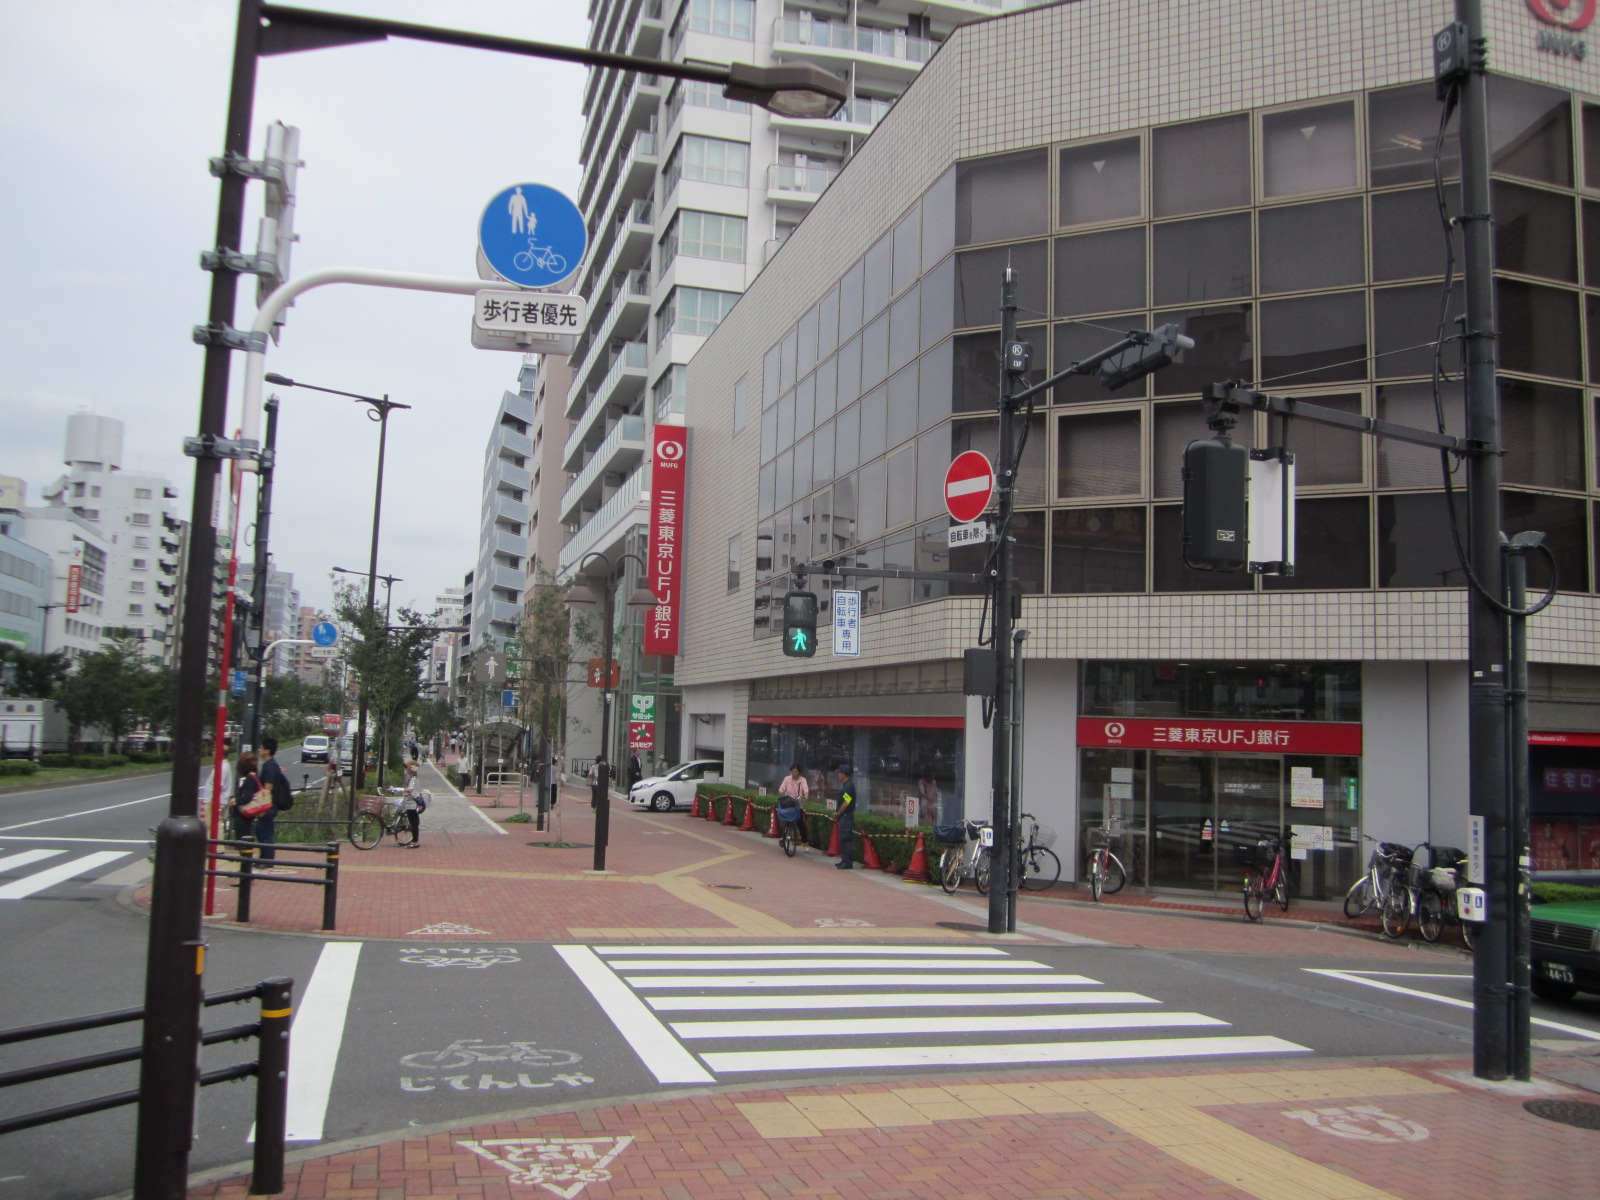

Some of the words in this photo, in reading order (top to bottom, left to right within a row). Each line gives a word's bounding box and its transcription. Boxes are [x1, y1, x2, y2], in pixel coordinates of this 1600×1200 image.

[483, 299, 577, 326] 歩行者優先
[951, 527, 983, 542] 自転車を除く
[654, 490, 676, 639] 三菱東京UFJ銀行
[837, 596, 846, 628] 自転車
[848, 596, 857, 628] 歩行者
[842, 630, 851, 650] 専用
[1153, 727, 1290, 746] 三菱東京UFJ銀行
[1545, 771, 1600, 789] 住宅ロ
